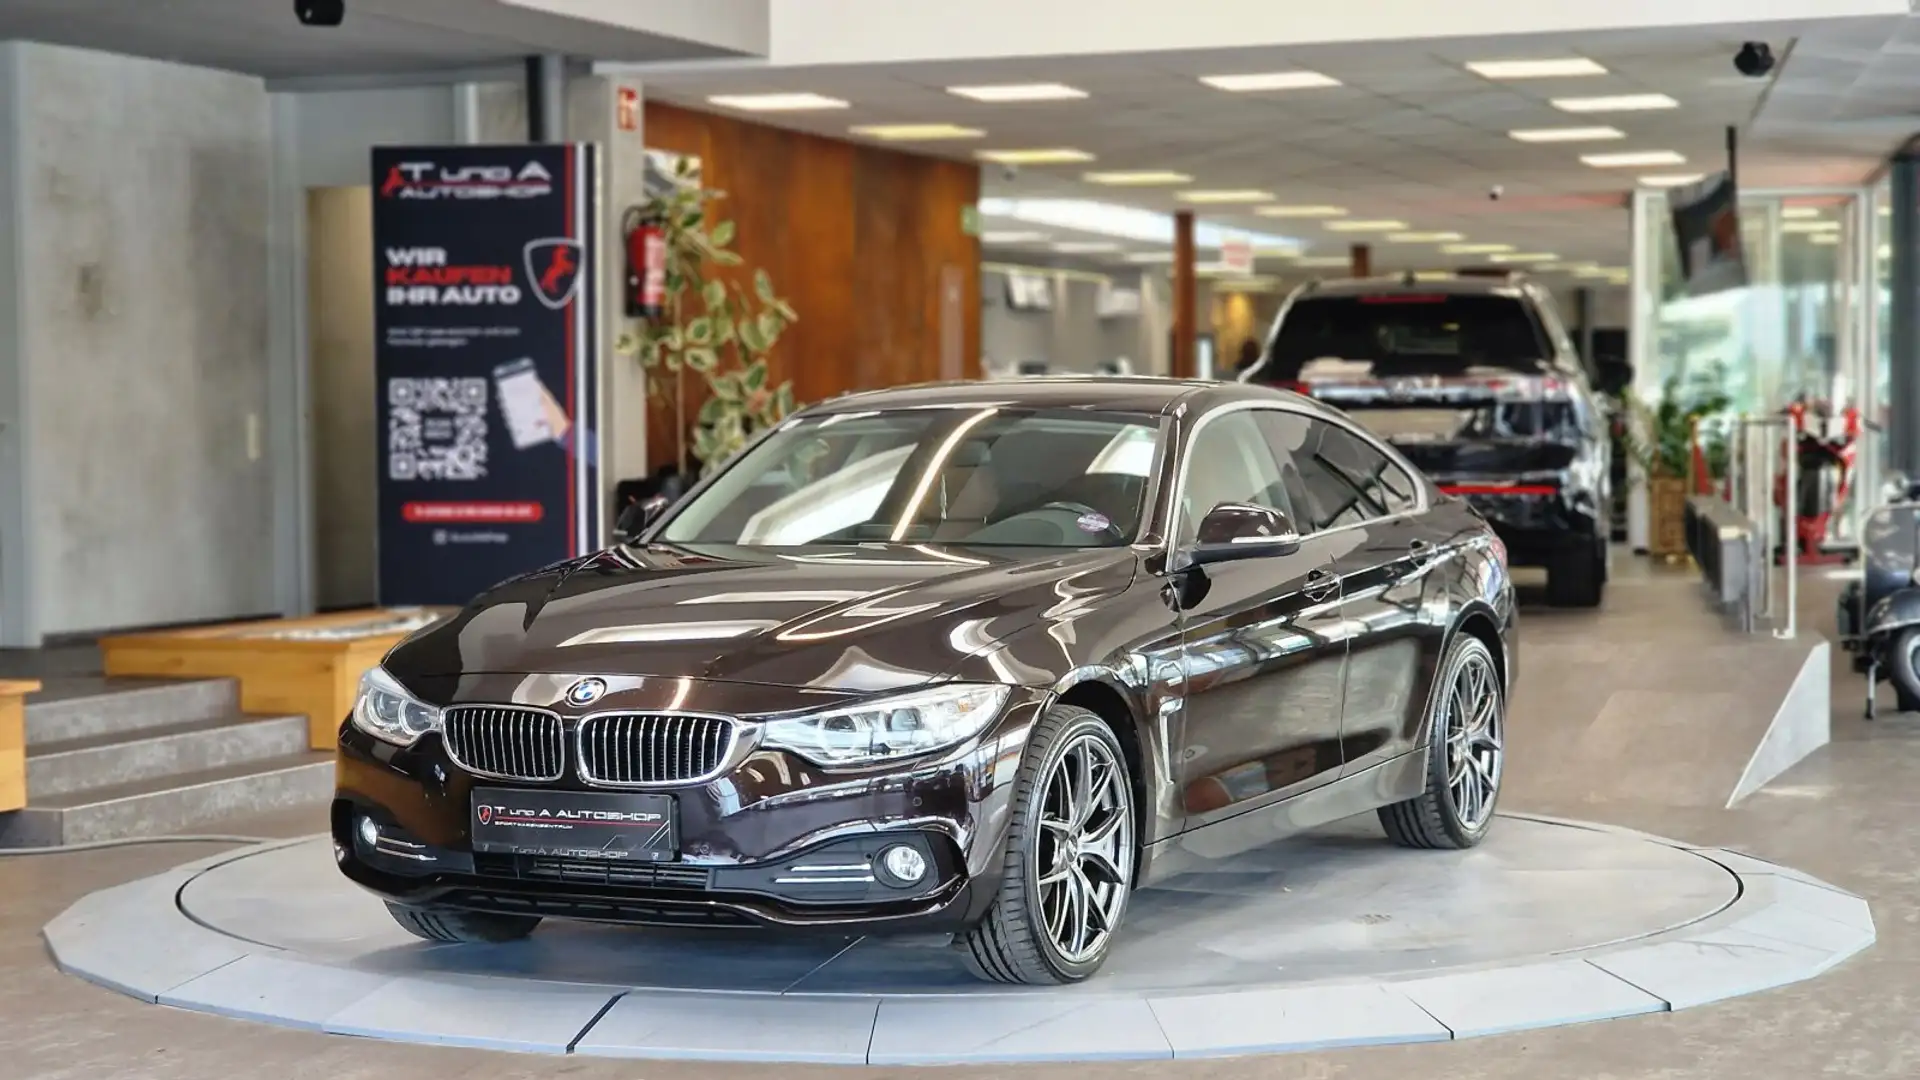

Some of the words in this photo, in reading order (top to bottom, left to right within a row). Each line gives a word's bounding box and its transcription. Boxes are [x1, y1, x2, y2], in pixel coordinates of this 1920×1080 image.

[398, 162, 434, 181] T
[516, 160, 552, 181] A
[399, 185, 552, 199] AUTOSHOP
[386, 247, 447, 266] WIR
[385, 266, 512, 285] KAUFEN
[387, 286, 438, 305] IHR
[441, 286, 521, 304] AUTO
[494, 806, 505, 814] T
[539, 809, 551, 817] A
[556, 810, 661, 821] AUTOSHOP
[551, 848, 628, 859] AUTOSHOP
